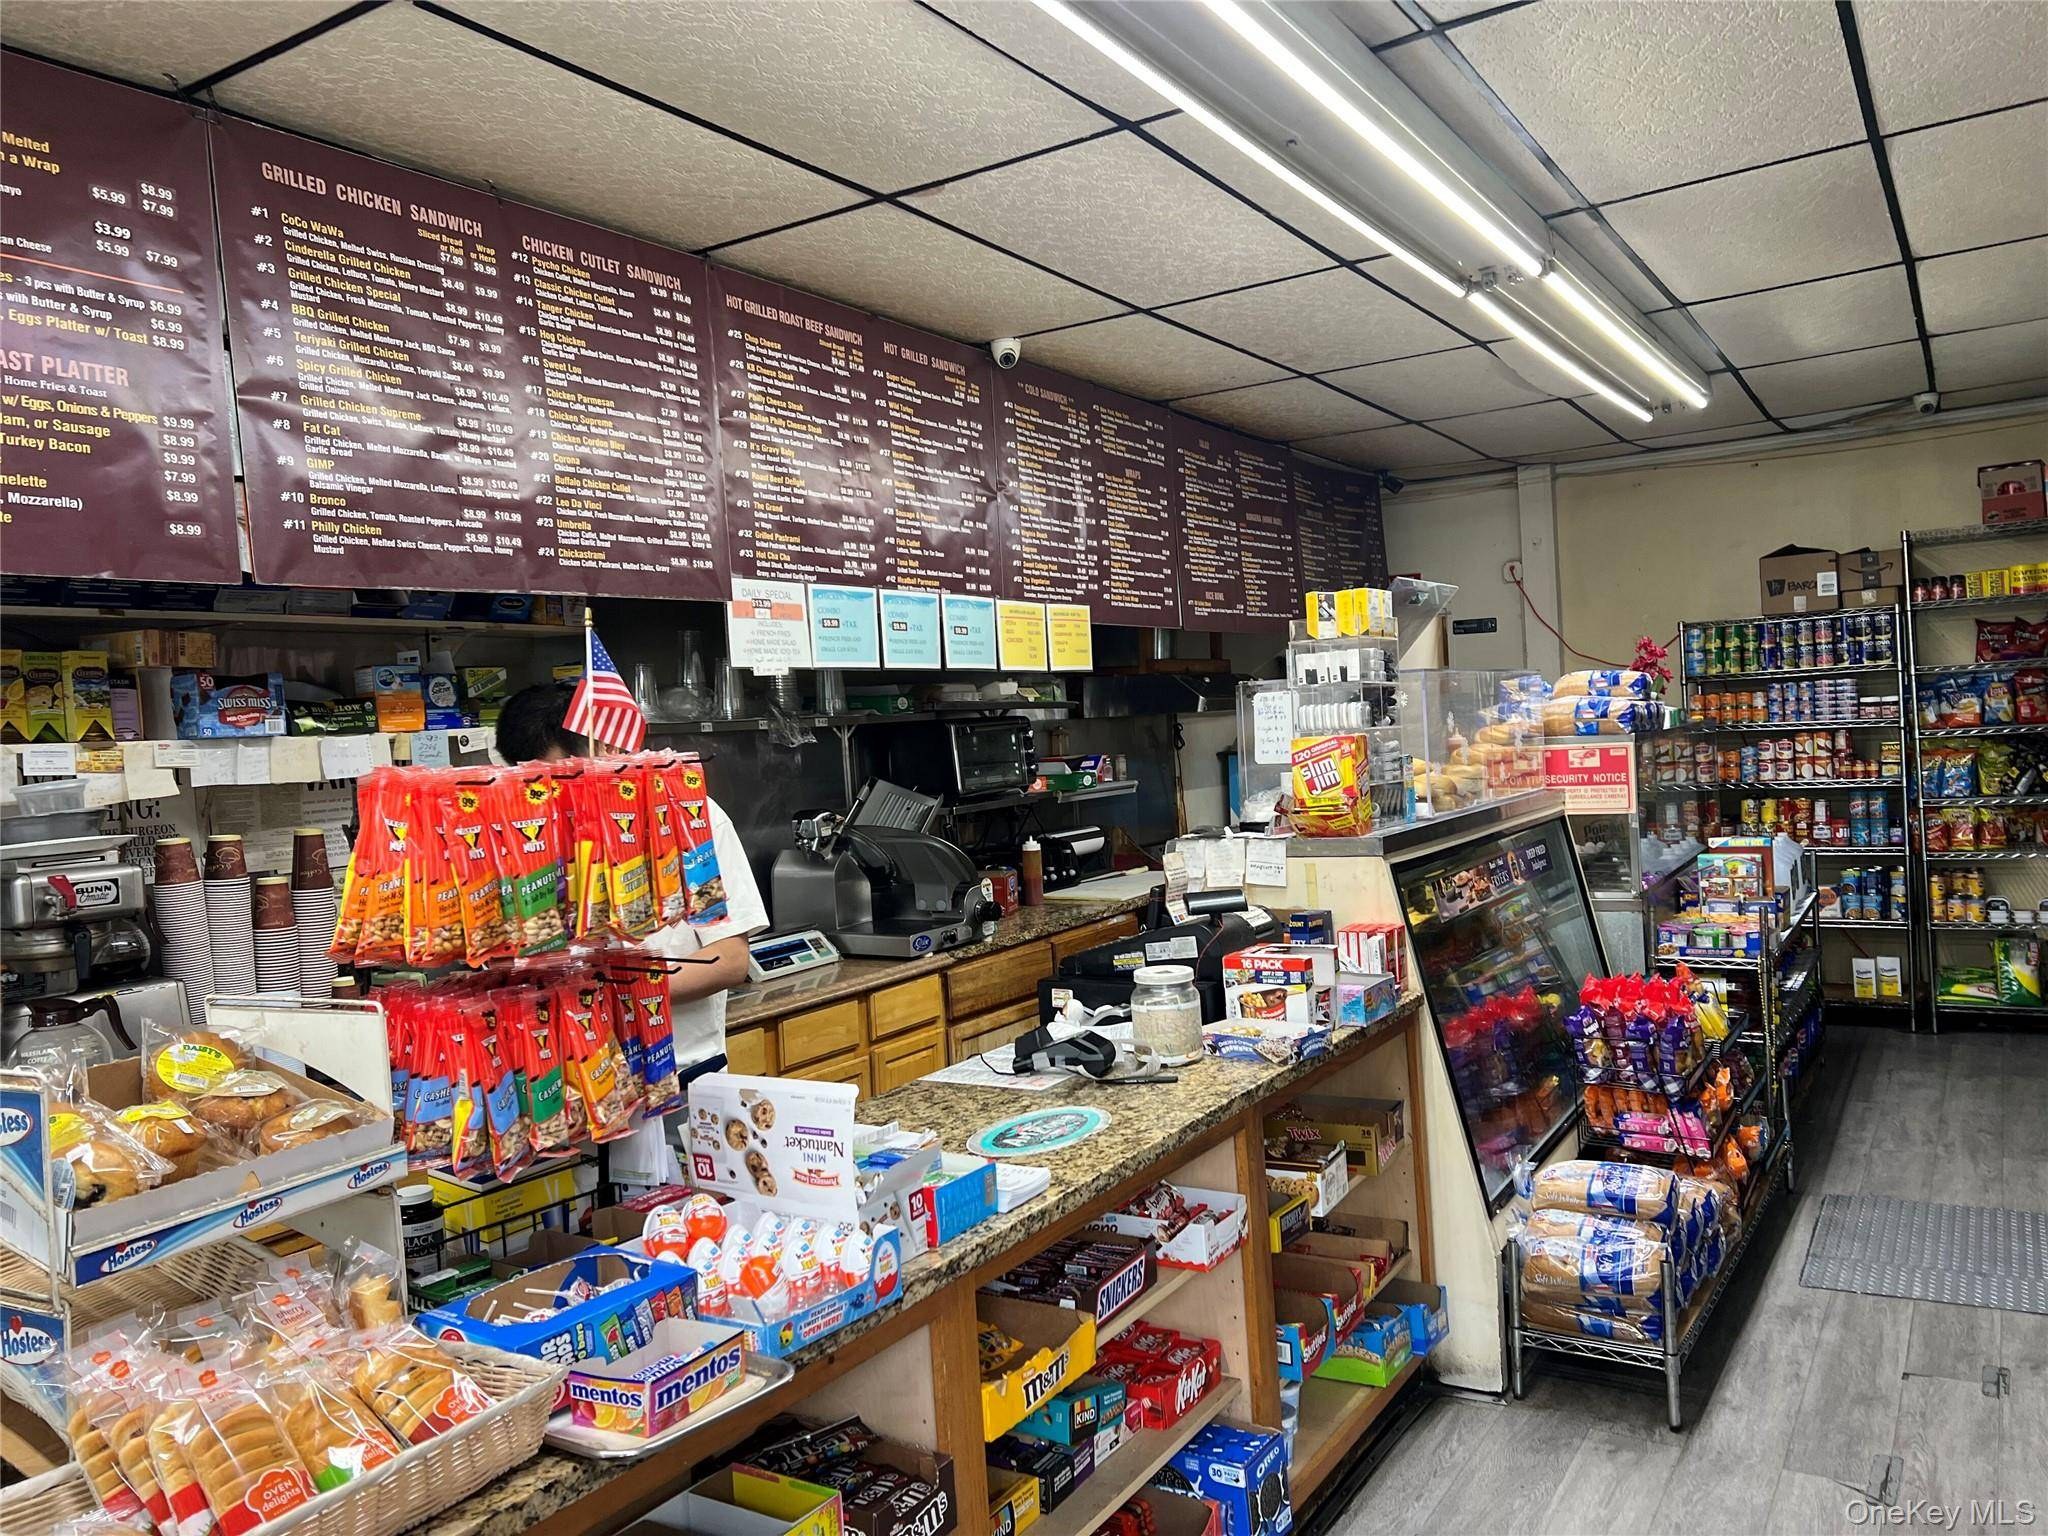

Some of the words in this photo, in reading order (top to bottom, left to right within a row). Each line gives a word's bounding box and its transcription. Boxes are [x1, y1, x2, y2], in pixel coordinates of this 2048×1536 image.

[1, 131, 50, 153] Melted
[22, 155, 60, 175] Wrap
[92, 186, 126, 205] $5.99
[141, 182, 173, 200] $8.99
[261, 161, 327, 196] GRILLED
[336, 183, 402, 216] CHICKEN
[410, 204, 483, 238] SANDWICH
[142, 200, 174, 218] $7.99
[95, 221, 131, 240] $3.99
[250, 206, 269, 219] #1
[280, 212, 308, 230] CoCo
[310, 220, 344, 239] WaWa
[16, 237, 52, 253] Cheese
[96, 240, 130, 257] $5.99
[146, 250, 178, 268] $7.99
[284, 239, 336, 263] Cinderella
[522, 235, 574, 263] CHICKEN
[580, 251, 620, 275] CUTLET
[626, 264, 682, 291] SANDWICH
[25, 276, 32, 286] 3
[34, 278, 53, 293] pcs
[54, 282, 75, 294] with
[77, 286, 106, 302] Butter
[108, 291, 116, 304] &
[118, 294, 146, 311] Syrup
[365, 285, 401, 303] Special
[6, 292, 29, 305] with
[31, 295, 66, 313] Butter
[82, 305, 113, 321] Syrup
[291, 303, 315, 319] BBQ
[317, 310, 350, 328] Grilled
[351, 316, 391, 334] Chicken
[725, 294, 743, 311] HOT
[744, 300, 778, 321] GRILLED
[779, 310, 804, 330] ROAST
[804, 318, 824, 334] BEEF
[824, 325, 863, 347] SANDWICH
[8, 309, 43, 328] Eggs
[46, 315, 91, 335] Platter
[94, 324, 110, 338] w/
[113, 327, 149, 345] Toast
[152, 334, 185, 351] $8.99
[293, 330, 337, 350] Teriyaki
[41, 356, 130, 387] PLATTER
[296, 357, 327, 379] Spicy
[4, 375, 38, 389] Home
[40, 379, 66, 393] Fries
[80, 384, 107, 398] Toast
[57, 402, 98, 417] Onions
[112, 408, 159, 426] Peppers
[163, 415, 195, 430] $9.99
[380, 405, 422, 422] Supreme
[53, 419, 111, 438] Sausage
[303, 421, 321, 435] Fat
[323, 423, 341, 437] Cat
[49, 437, 92, 455] Bacon
[306, 458, 335, 471] GIMP
[7, 491, 84, 511] Mozzarella)
[280, 491, 305, 504] #10
[309, 493, 347, 507] Bronco
[169, 523, 202, 536] $8.99
[282, 519, 306, 531] #11
[310, 520, 341, 536] Philly
[343, 523, 382, 537] Chicken
[200, 676, 214, 688] 50
[1545, 774, 1589, 785] SECURITY
[1593, 772, 1628, 783] NOTICE
[76, 884, 112, 895] BUNN
[1241, 958, 1253, 969] 16
[1254, 959, 1284, 970] PACK
[785, 1136, 844, 1158] Nantucket
[803, 1152, 826, 1164] MINI
[353, 1161, 391, 1187] Hostess
[239, 1198, 282, 1227] Hostess
[107, 1239, 156, 1270] Hostess
[1098, 1258, 1145, 1319] SNICKERS
[1336, 1301, 1357, 1332] Skittles
[2, 1330, 56, 1358] Hostess
[1303, 1332, 1327, 1363] Skittles
[656, 1346, 741, 1411] mentos
[571, 1381, 643, 1408] mentos
[1076, 1408, 1096, 1425] KIND
[1211, 1467, 1222, 1478] 30
[262, 1488, 301, 1513] delights
[263, 1480, 292, 1500] OVEN
